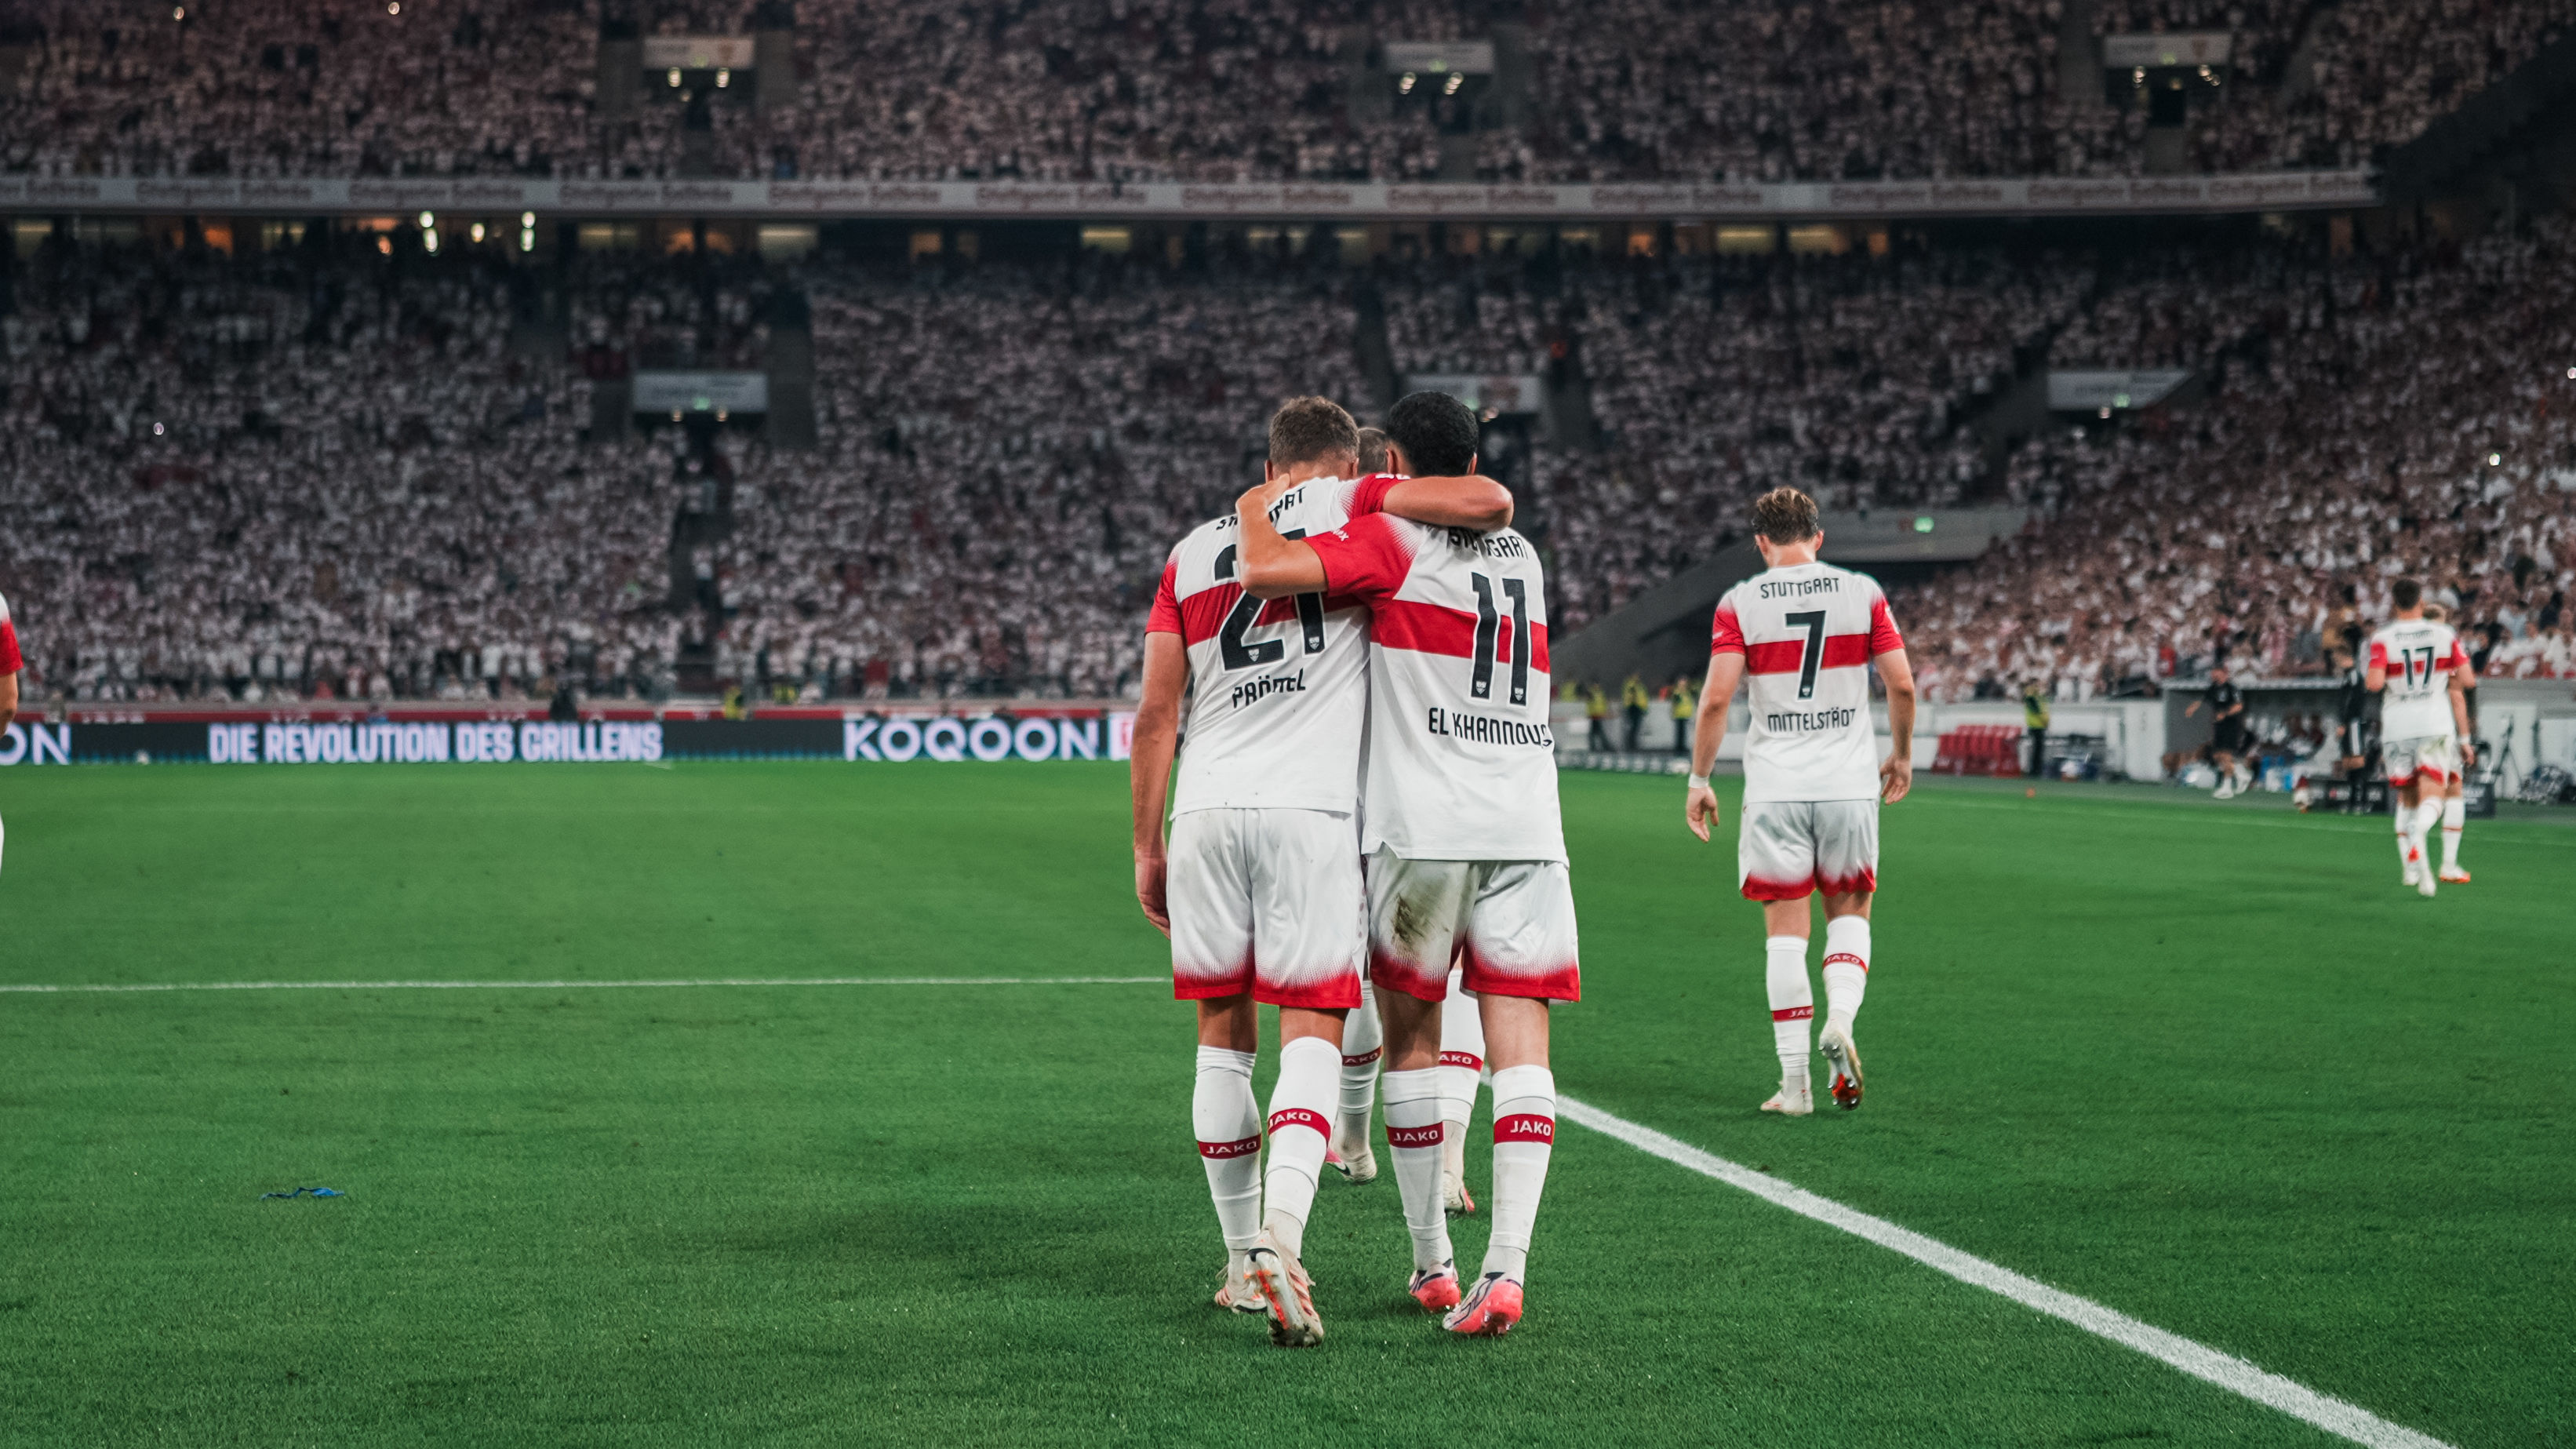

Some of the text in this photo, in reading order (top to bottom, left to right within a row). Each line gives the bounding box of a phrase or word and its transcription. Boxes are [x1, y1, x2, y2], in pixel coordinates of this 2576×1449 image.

[1760, 577, 1839, 599] STUTTGART
[1471, 571, 1529, 707] 11
[1785, 610, 1826, 699] 7
[2401, 646, 2434, 690] 17
[1428, 707, 1449, 735] EL
[1767, 707, 1856, 733] MITTELSTÄDT
[0, 722, 71, 766] ON
[209, 721, 664, 763] DIE REVOLUTION DES GRILLENS
[842, 717, 1098, 762] KOQOON
[1826, 955, 1860, 964] JAKO
[1344, 1053, 1378, 1064] AKO
[1439, 1054, 1472, 1065] AKO
[1269, 1112, 1312, 1128] JAKO
[1510, 1120, 1552, 1136] JAKO
[1206, 1141, 1257, 1154] JAKO
[1394, 1130, 1439, 1142] JAKO
